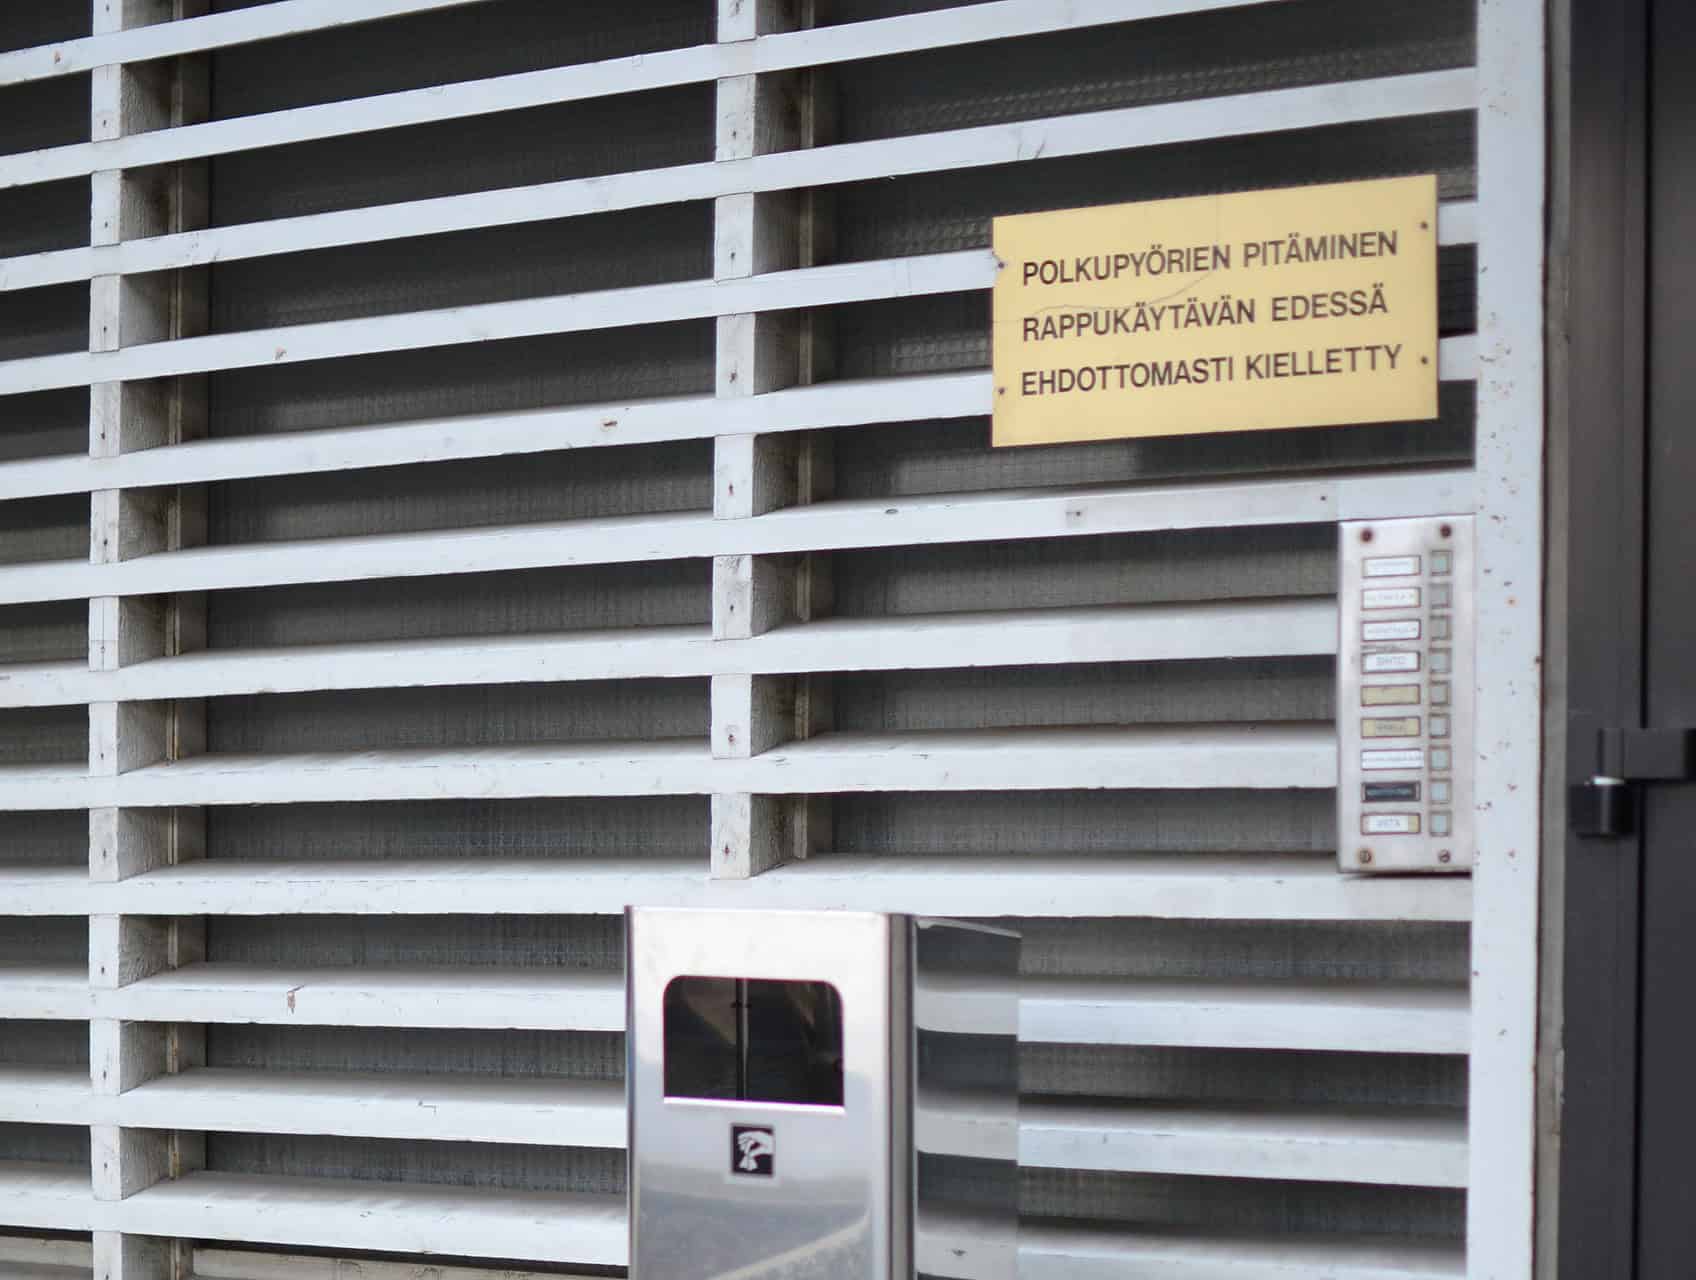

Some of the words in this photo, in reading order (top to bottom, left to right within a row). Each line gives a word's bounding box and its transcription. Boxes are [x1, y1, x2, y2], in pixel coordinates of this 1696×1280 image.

[1022, 244, 1230, 287] POLKUPYÖRIEN
[1243, 229, 1398, 269] PITÄMINEN
[1022, 295, 1254, 342] RAPPUKÄYTÄVÄN
[1272, 283, 1388, 322] EDESSÄ
[1022, 357, 1234, 396] EHDOTTOMASTI
[1246, 343, 1402, 381] KIELLETTY
